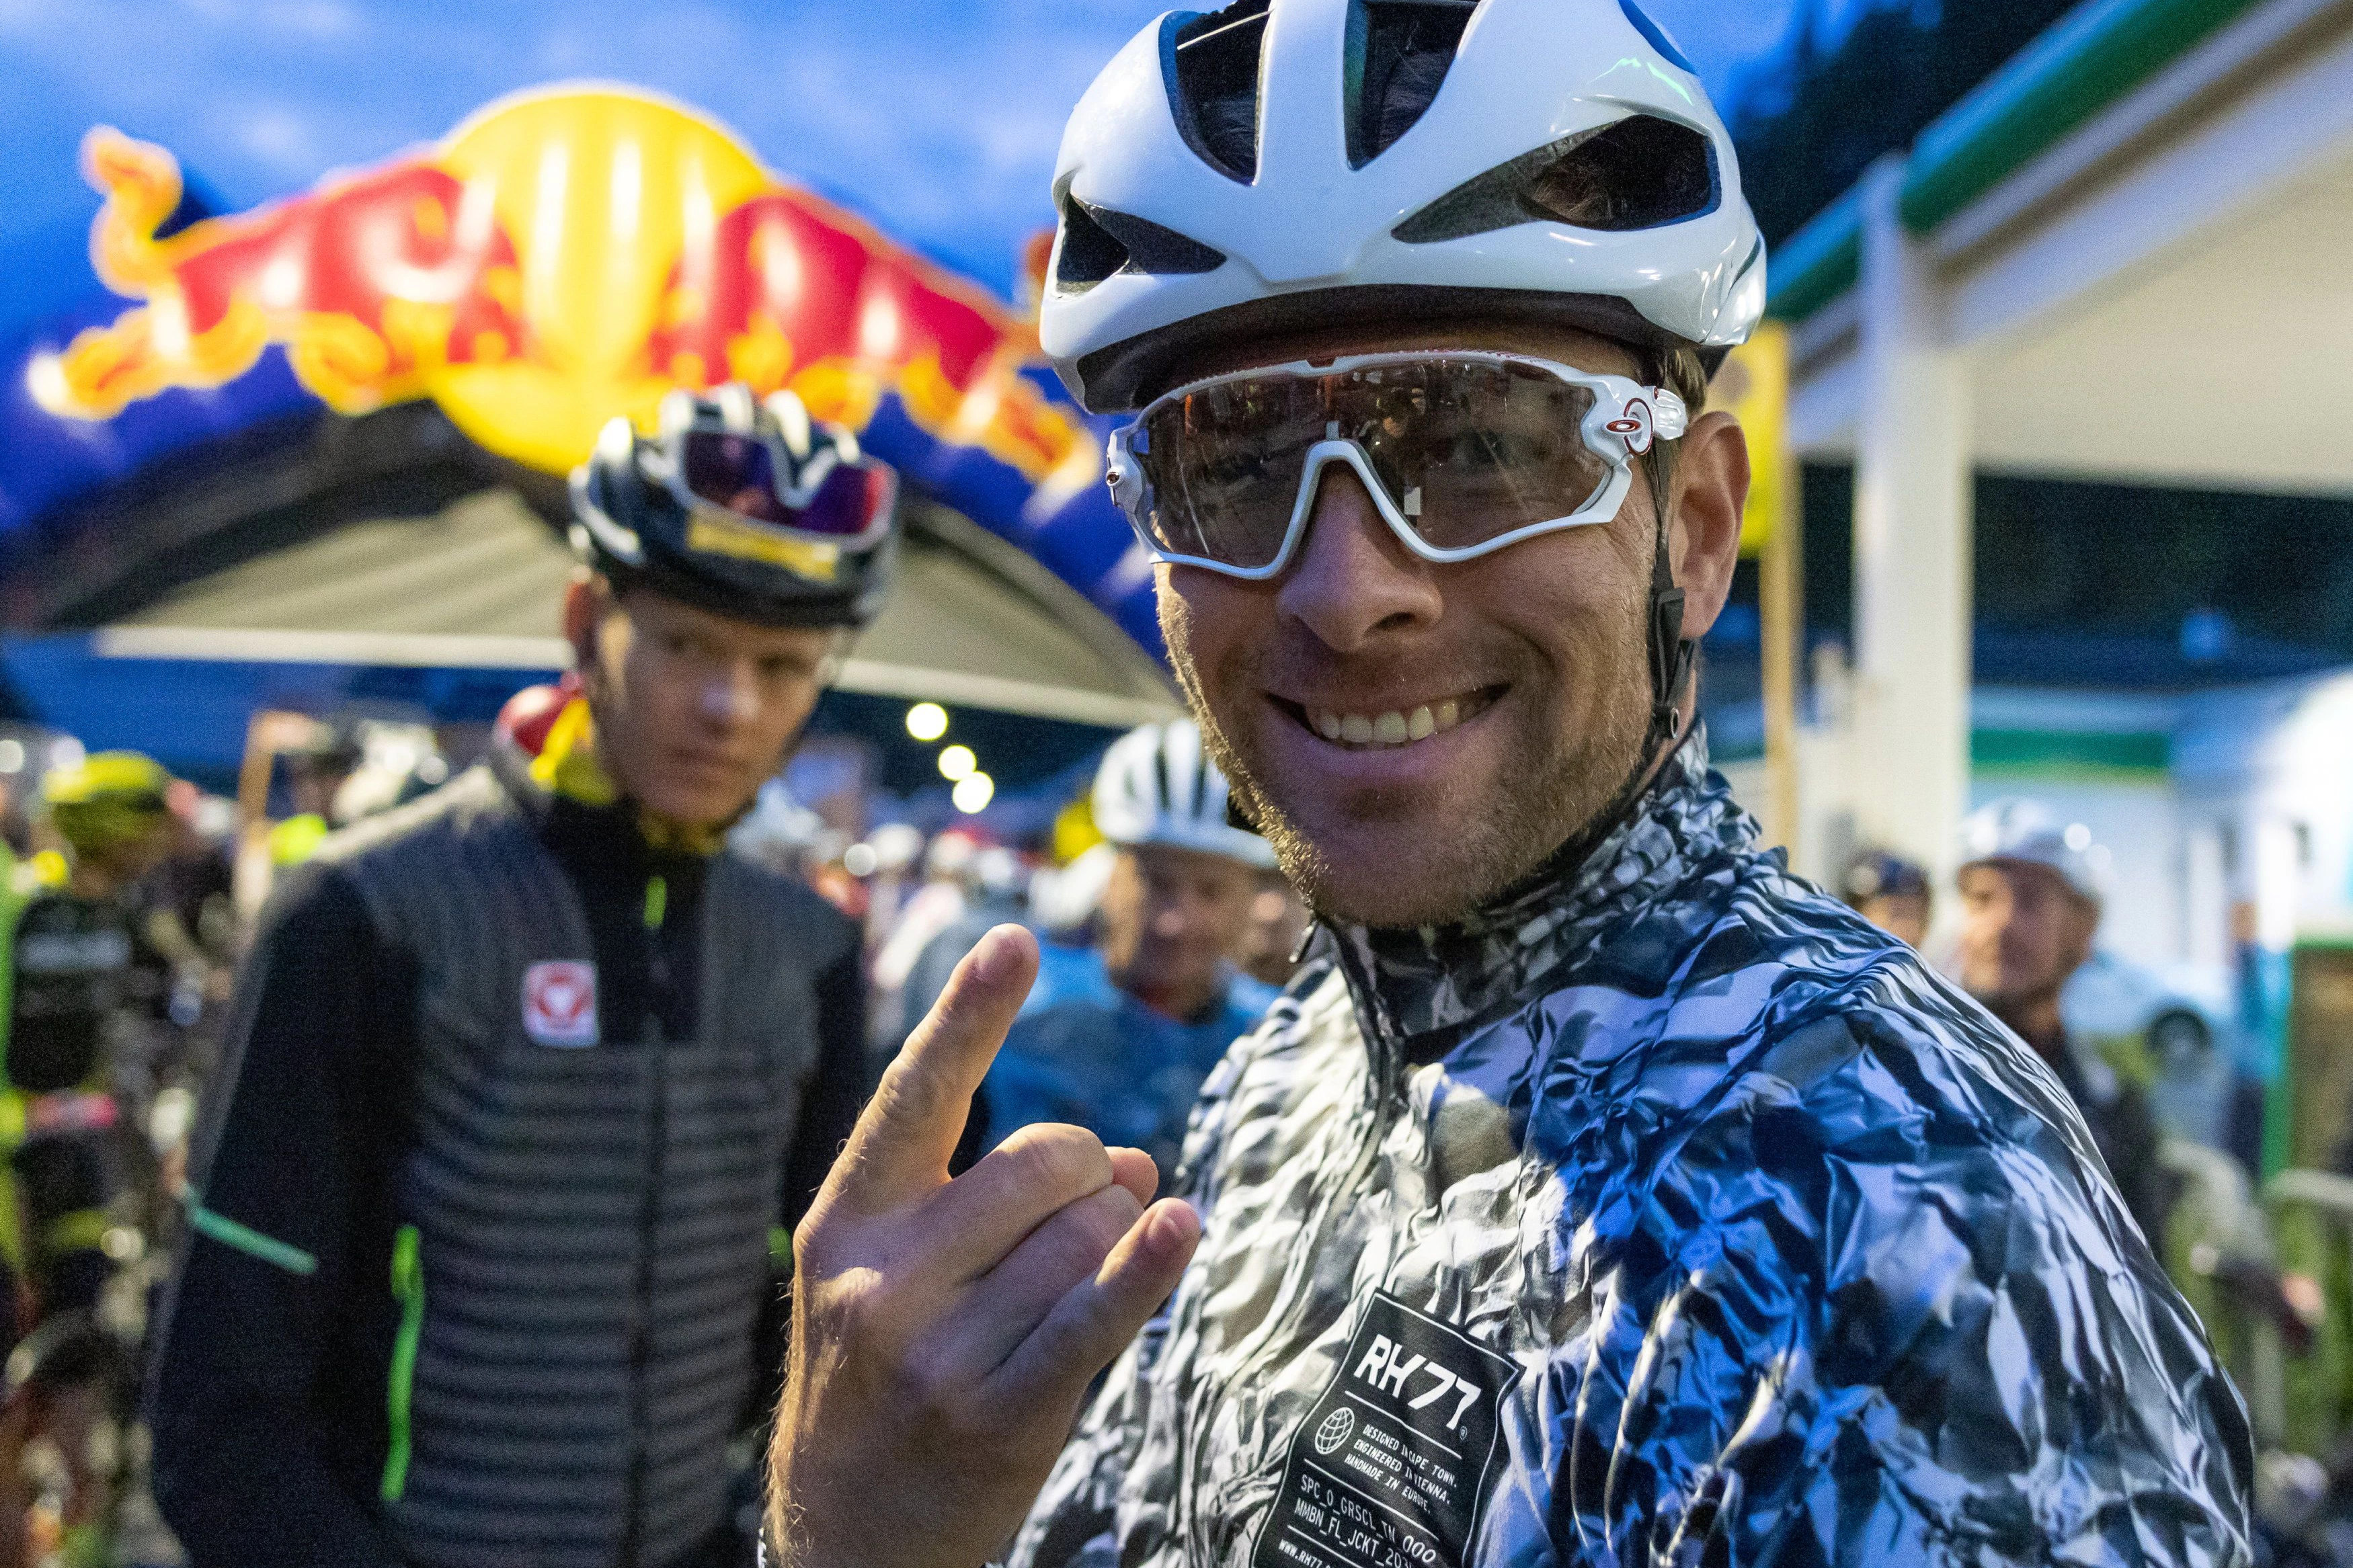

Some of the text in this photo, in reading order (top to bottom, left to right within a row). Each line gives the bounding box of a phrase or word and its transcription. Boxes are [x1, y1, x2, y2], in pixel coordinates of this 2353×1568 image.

[1344, 1453, 1430, 1514] HANDMADE IN EUROPE.
[1353, 1438, 1450, 1505] ENGINEERED IN VIENNA.
[1363, 1423, 1457, 1487] DESIGNED IN CAPE TOWN.
